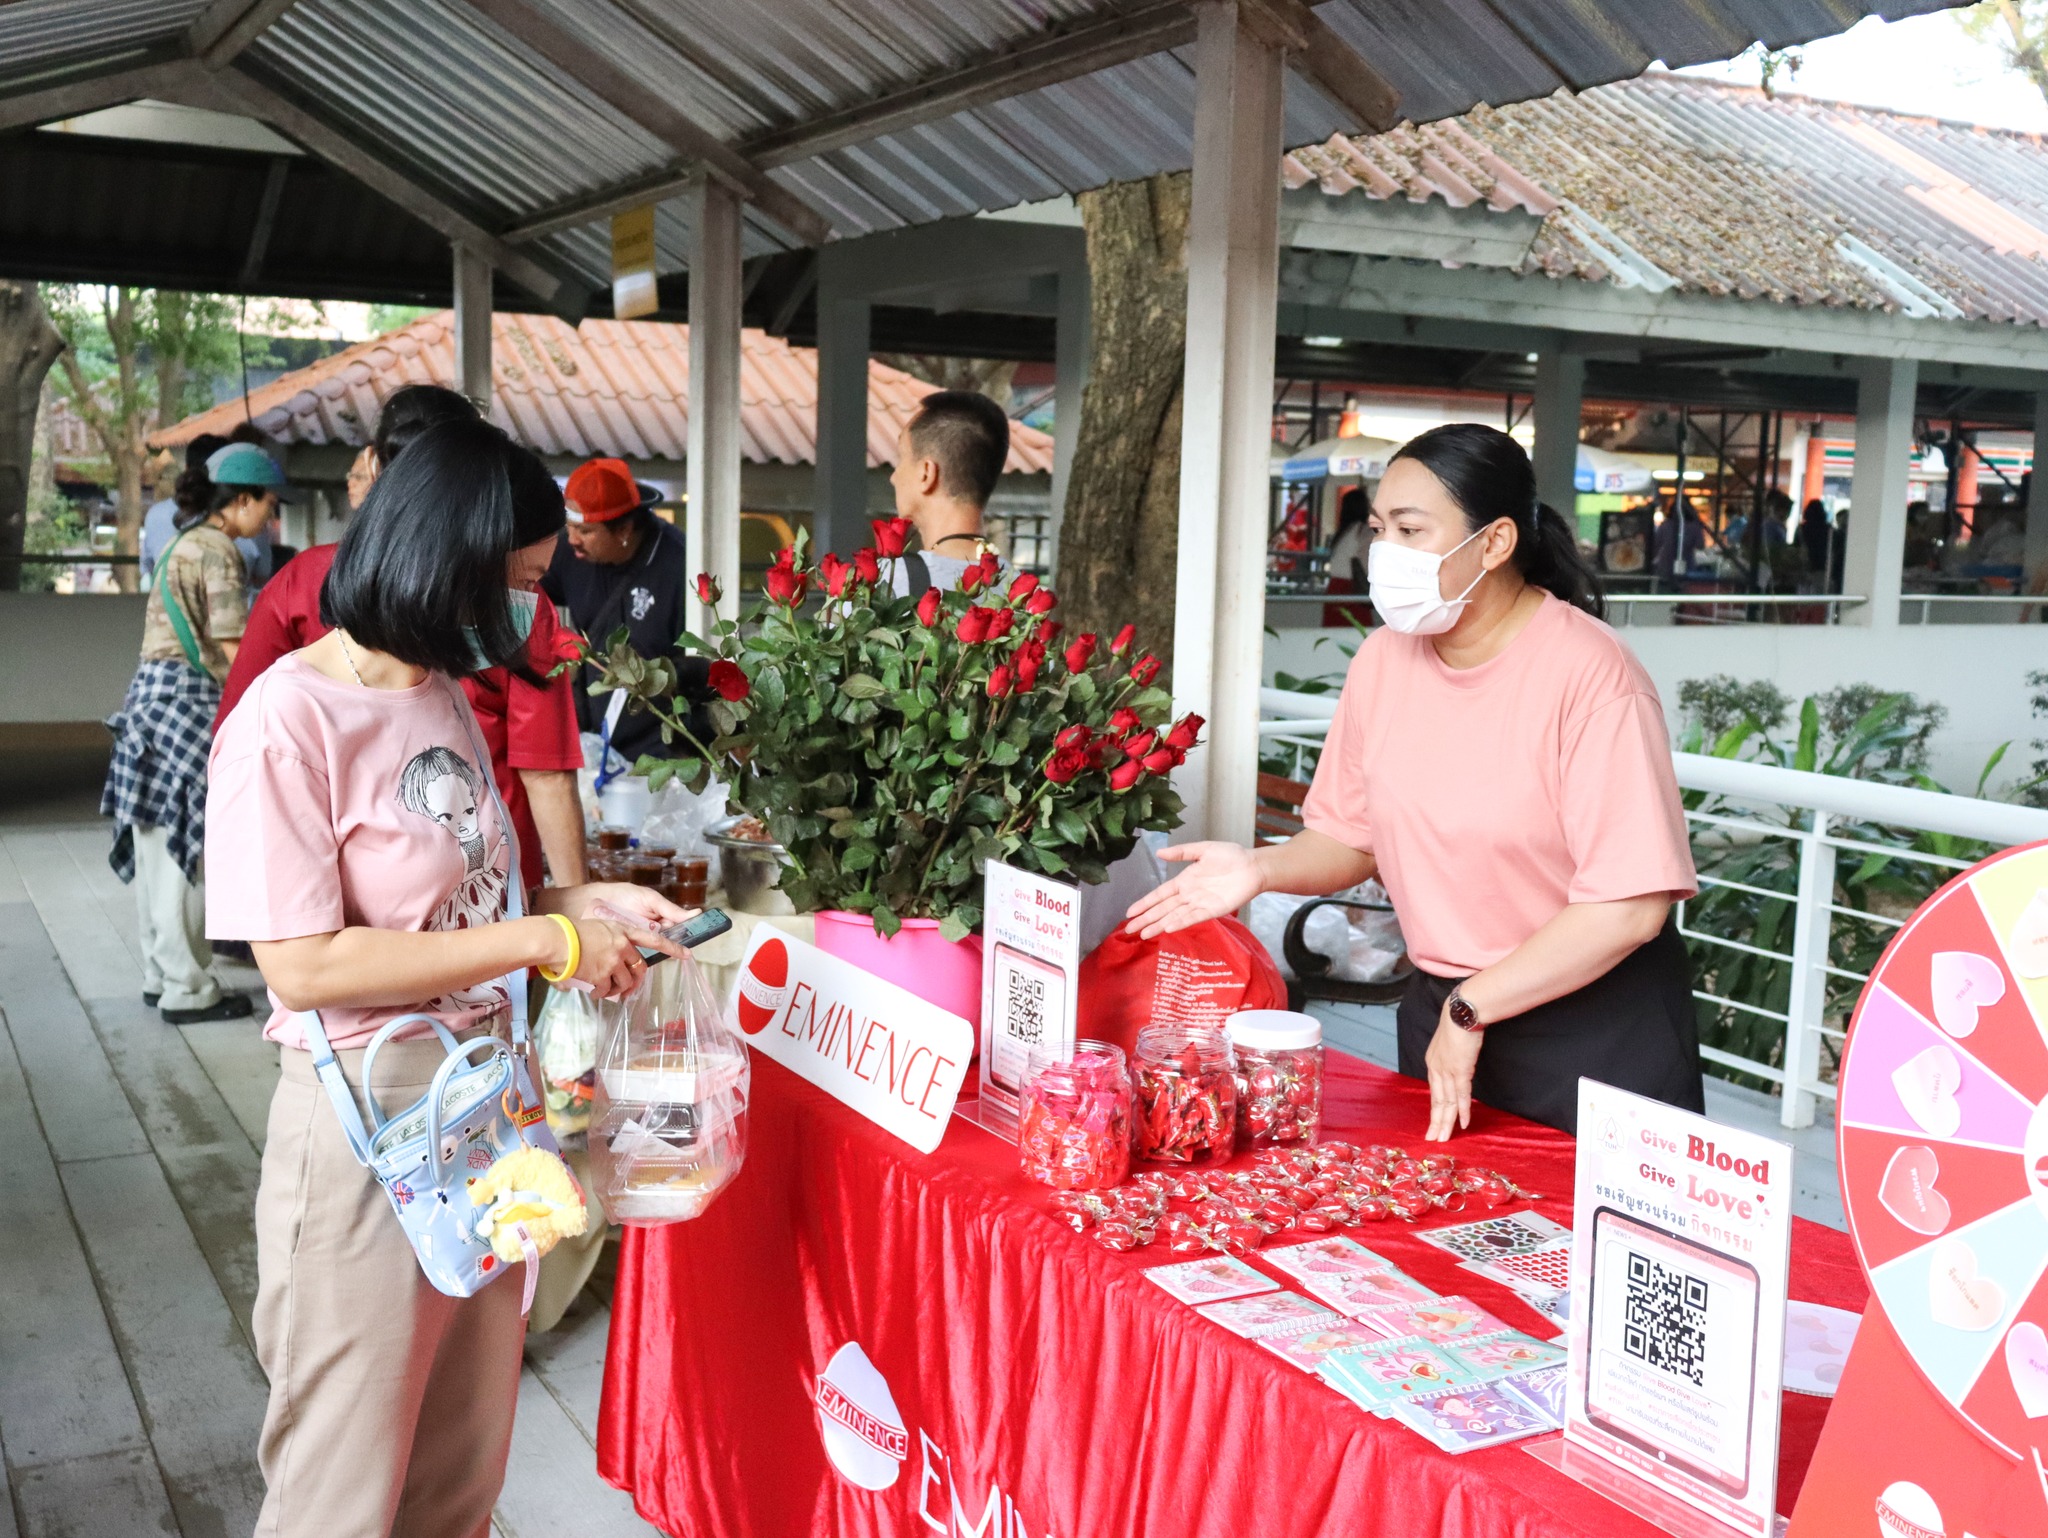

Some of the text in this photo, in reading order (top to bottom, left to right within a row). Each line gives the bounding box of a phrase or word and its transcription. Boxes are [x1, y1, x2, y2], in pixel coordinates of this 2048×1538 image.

[1604, 473, 1624, 488] BTS
[1014, 888, 1070, 916] Give Blood
[1014, 910, 1063, 939] Give Love
[740, 975, 782, 1007] EMINENCE
[781, 981, 956, 1120] EMINENCE
[1640, 1129, 1769, 1185] Give Blood
[1639, 1163, 1752, 1219] Give Love
[1691, 1213, 1752, 1252] กิจกรรม
[820, 1383, 905, 1455] EMINENCE
